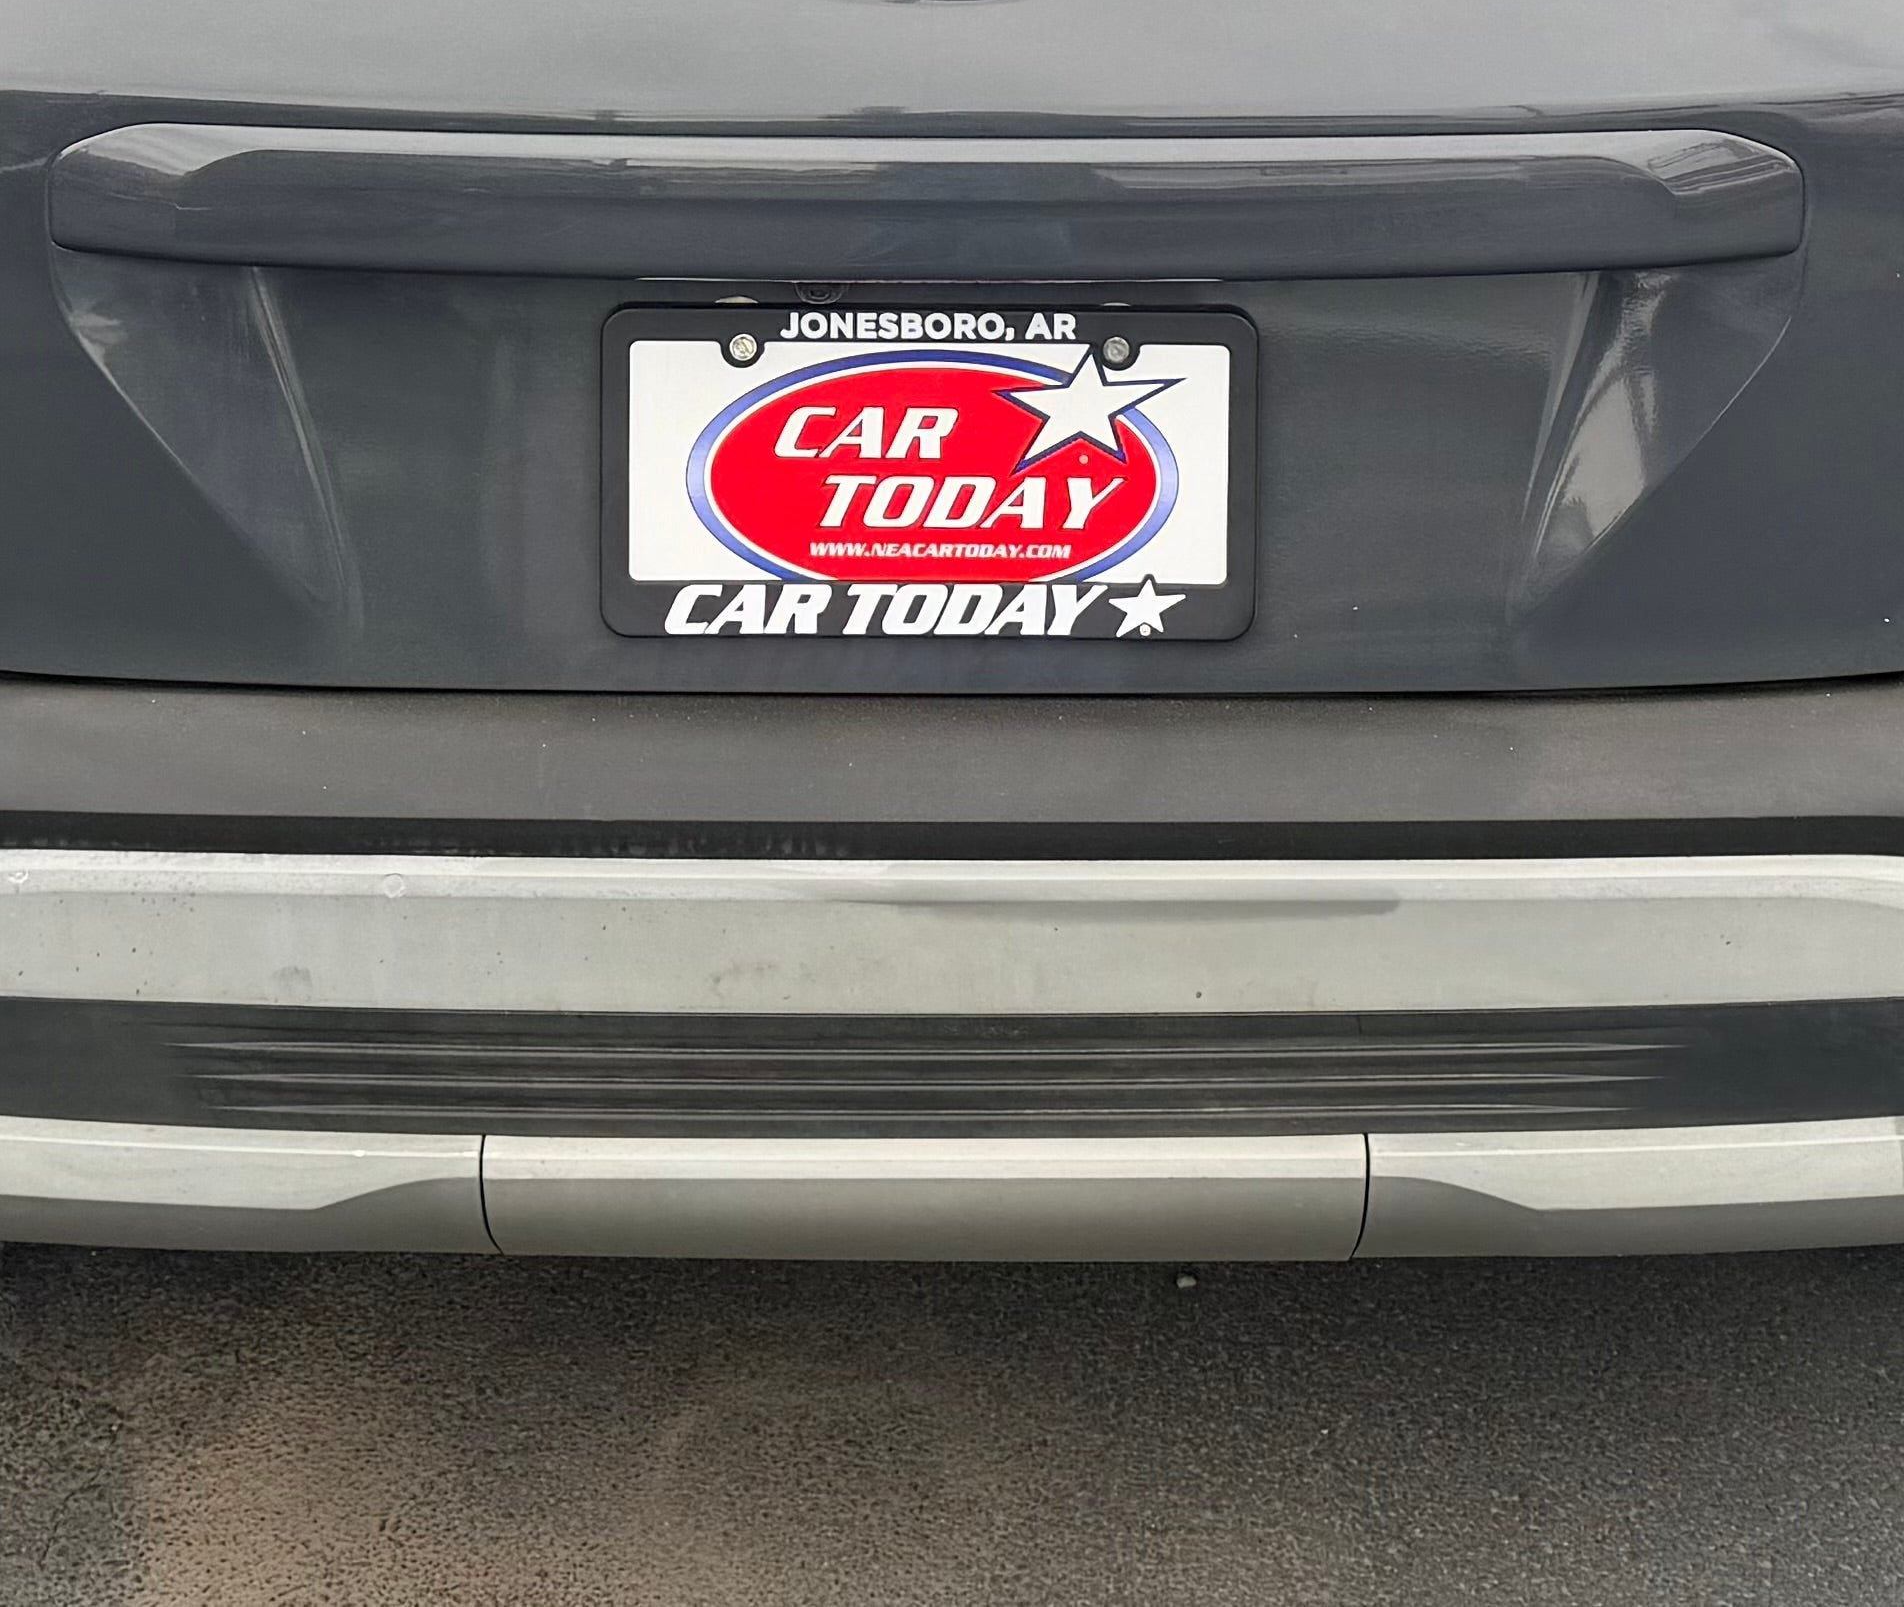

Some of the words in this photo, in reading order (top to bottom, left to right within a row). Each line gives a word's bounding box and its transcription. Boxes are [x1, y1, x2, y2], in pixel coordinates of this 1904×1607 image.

[779, 312, 1015, 342] JONESBORO,
[1023, 314, 1077, 340] AR
[773, 405, 960, 460] CAR
[820, 474, 1128, 531] TODAY
[809, 541, 1072, 560] WWW.NEACARTODAY.COM
[663, 583, 833, 636] CAR
[842, 583, 1108, 636] TODAY
